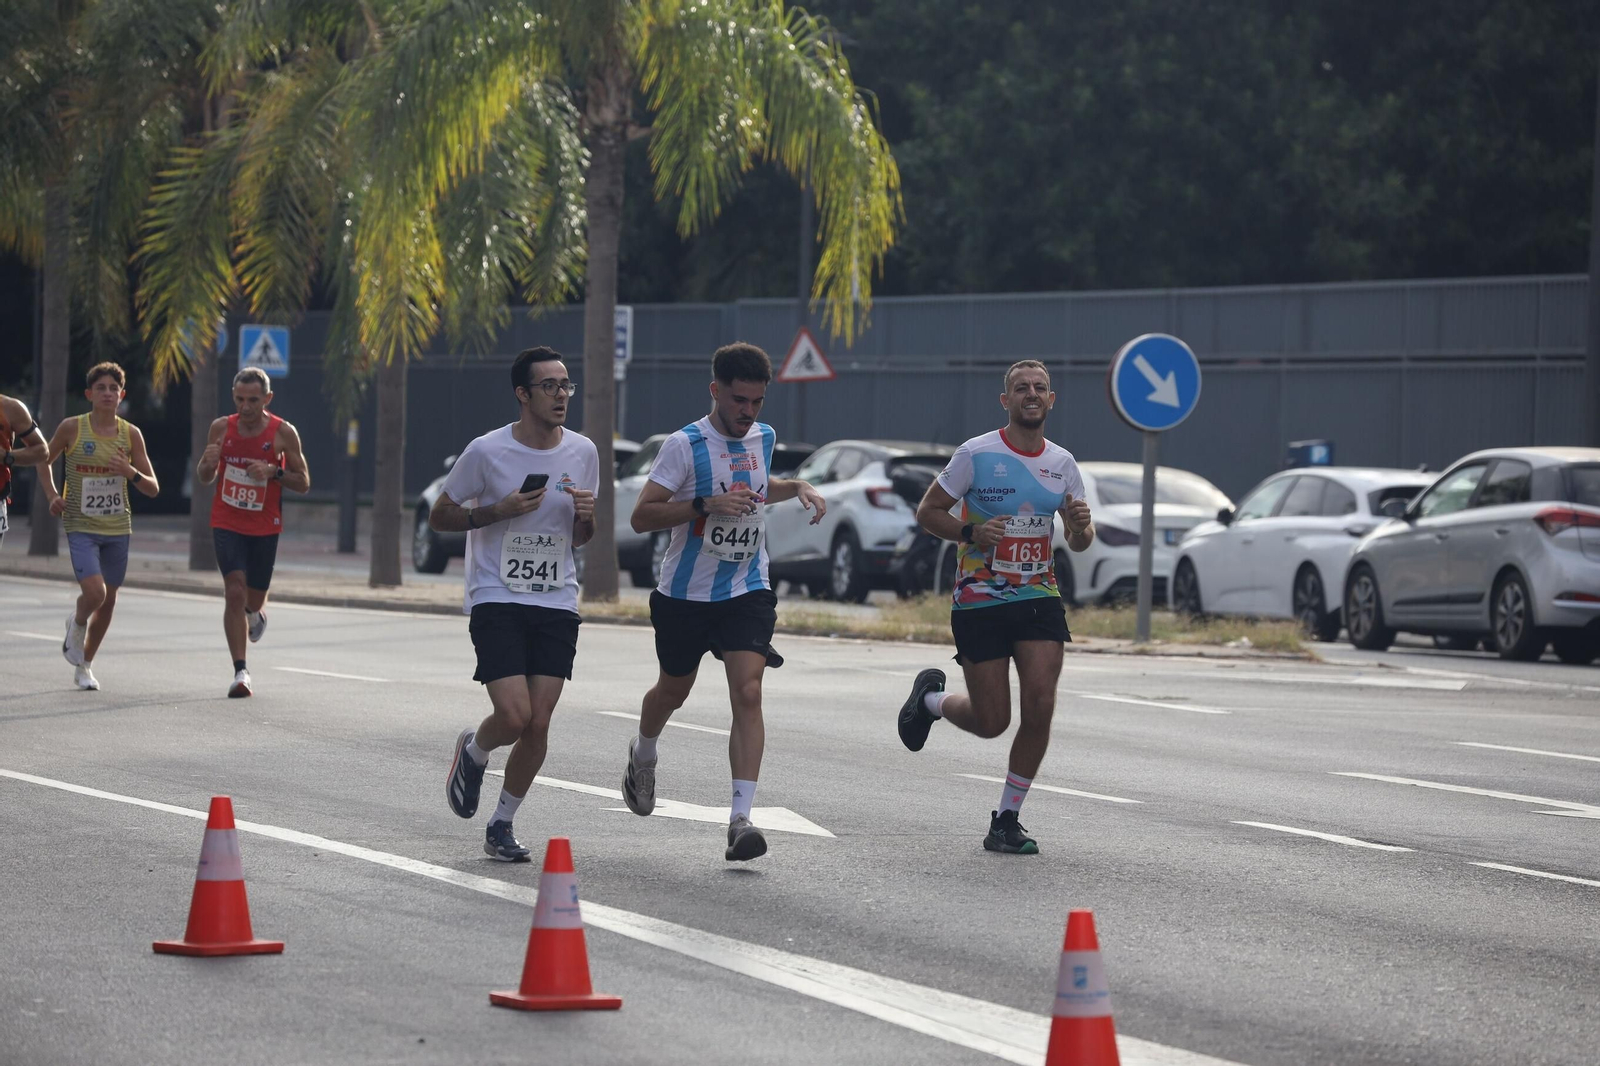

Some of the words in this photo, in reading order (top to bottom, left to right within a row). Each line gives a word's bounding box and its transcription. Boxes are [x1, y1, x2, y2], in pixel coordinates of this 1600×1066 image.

[229, 485, 257, 503] 189
[978, 487, 1016, 495] Málaga
[85, 492, 121, 509] 2236
[512, 536, 533, 546] 45
[711, 526, 759, 547] 6441
[1008, 542, 1041, 562] 163
[506, 559, 557, 581] 2541
